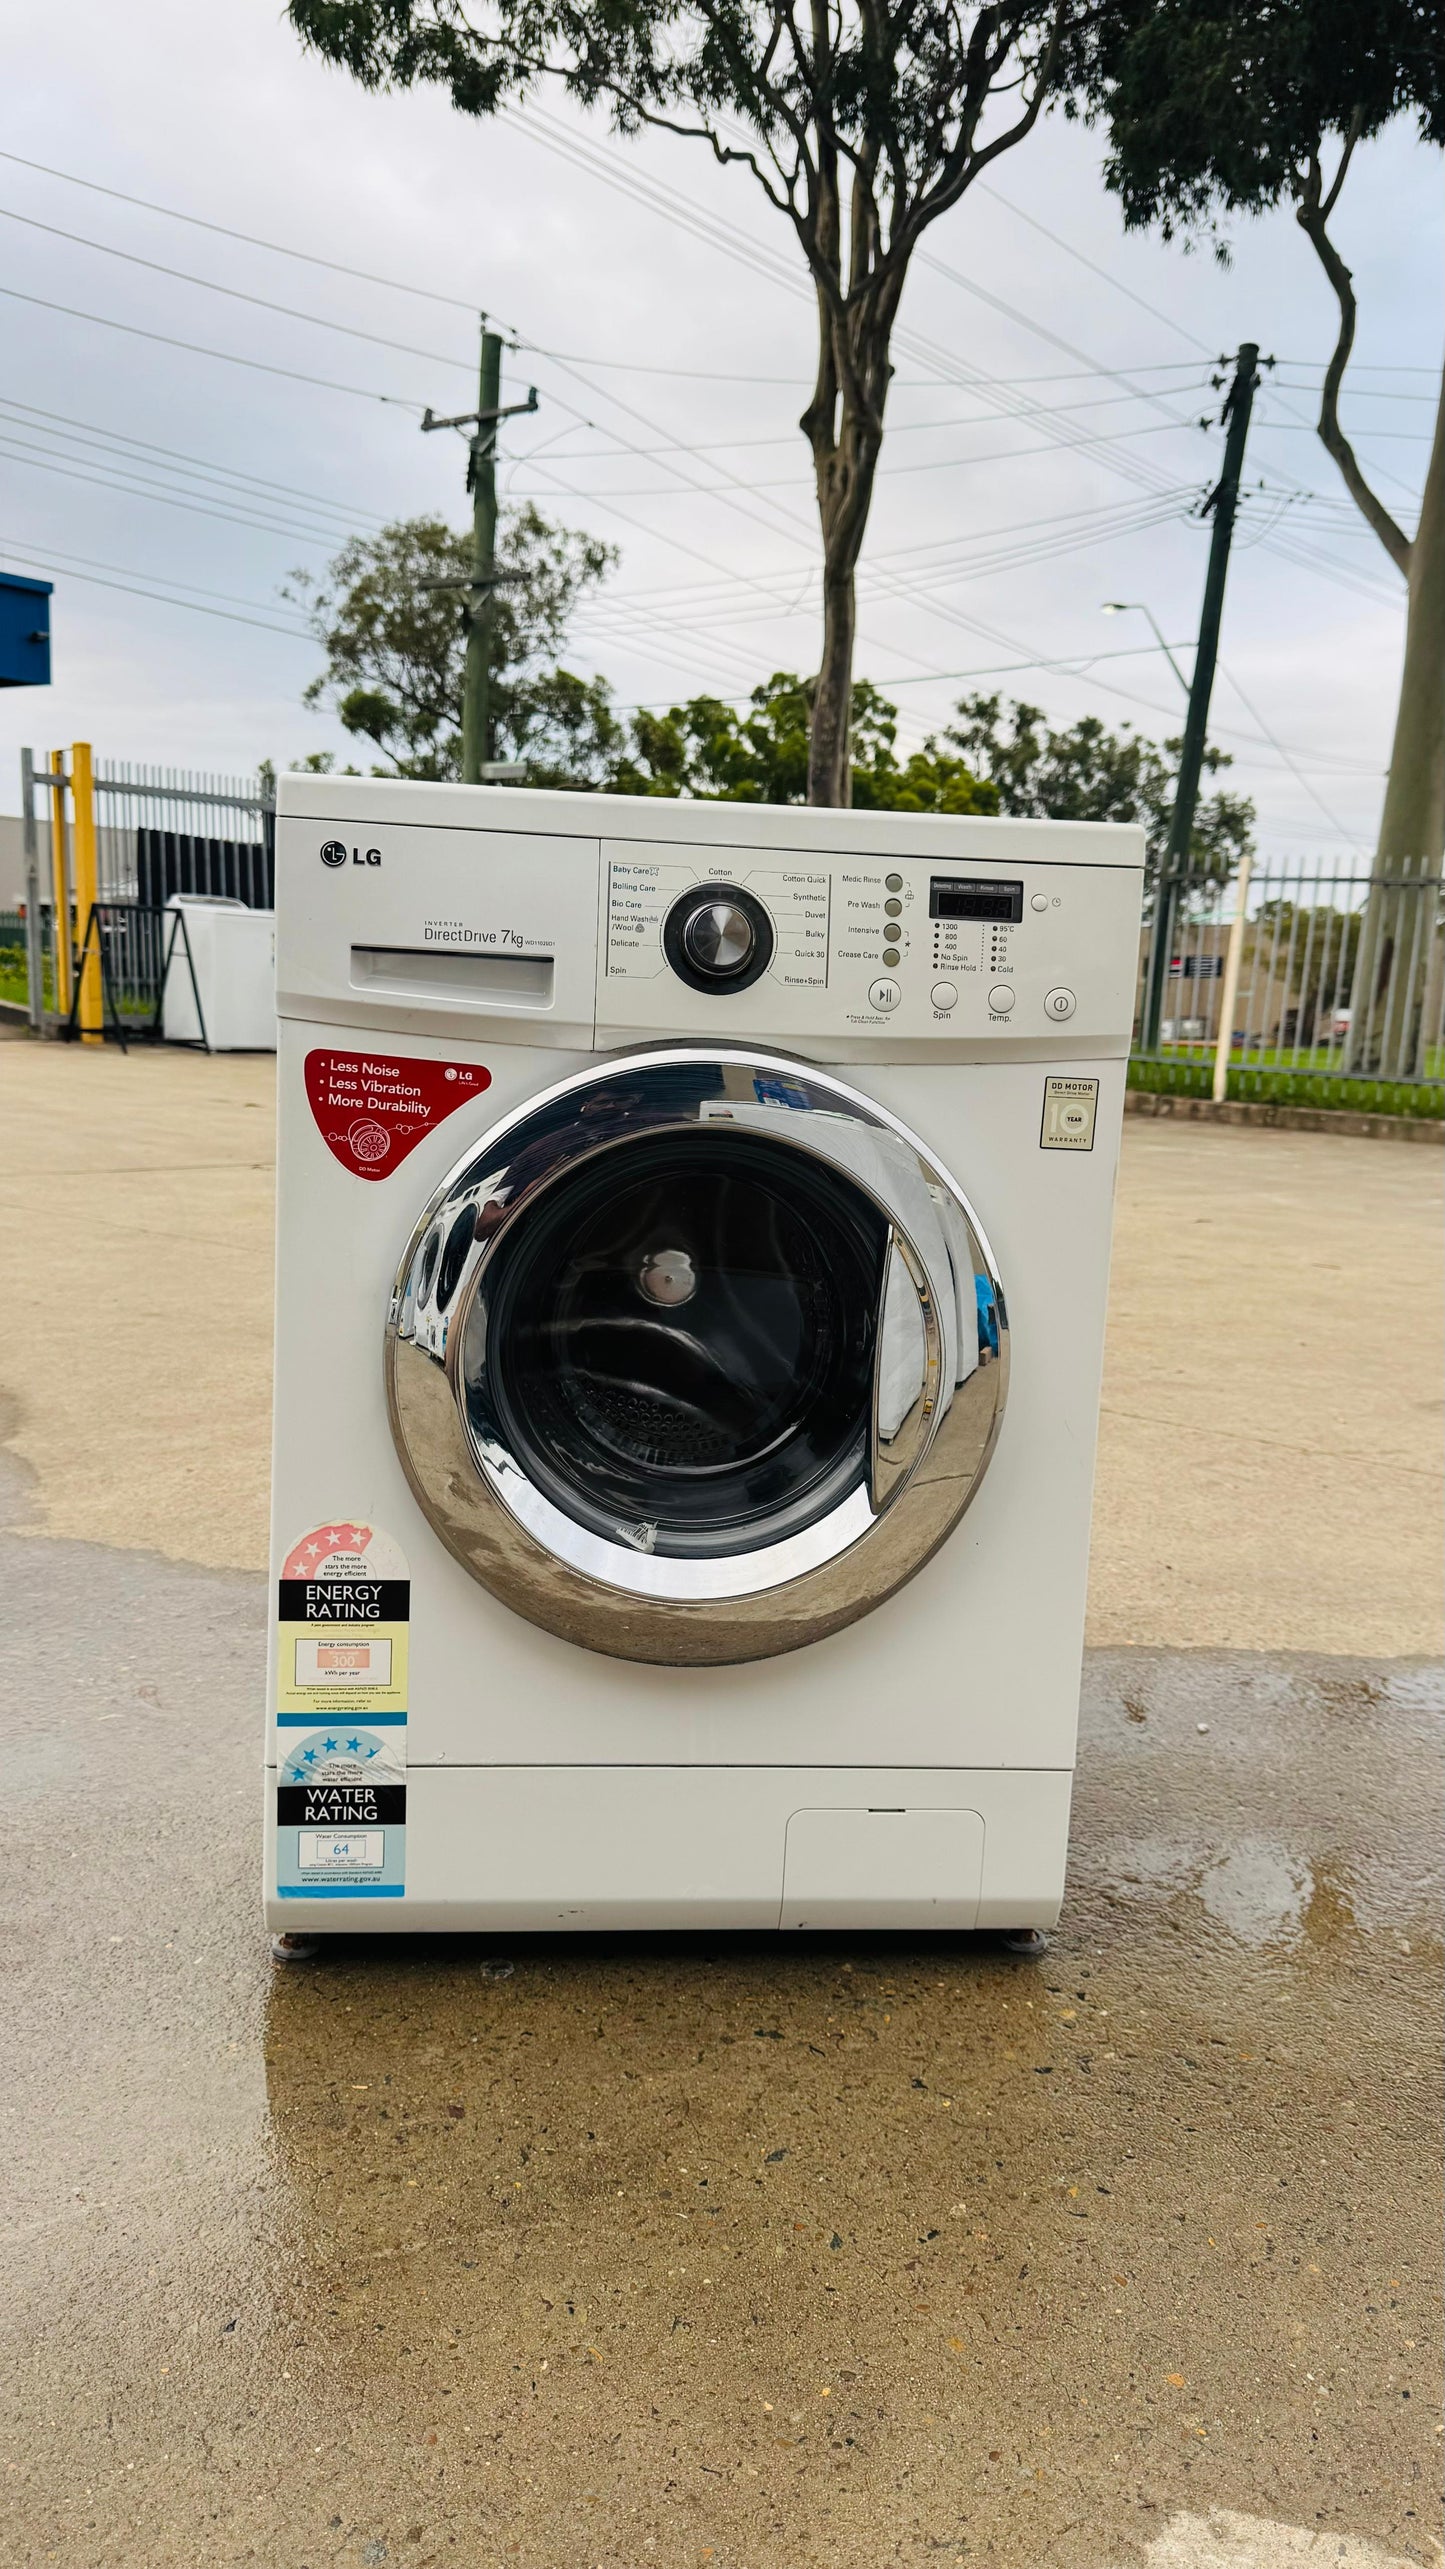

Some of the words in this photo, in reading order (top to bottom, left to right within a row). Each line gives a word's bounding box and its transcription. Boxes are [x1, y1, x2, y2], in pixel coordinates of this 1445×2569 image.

[353, 848, 381, 866] LG
[613, 865, 631, 874] Baby
[709, 868, 732, 876] Cotton
[842, 875, 862, 883] Medic
[863, 876, 881, 884] Rinse
[612, 882, 637, 892] Boiling
[639, 884, 656, 892] Care
[793, 893, 826, 901] Synthetic
[625, 900, 642, 908] Care
[847, 900, 859, 908] Pre
[861, 901, 880, 909] Wash
[805, 930, 825, 939] Bulky
[848, 926, 880, 935] Intensive
[501, 929, 523, 948] 7kg
[610, 939, 639, 947] Delicate
[838, 950, 861, 958] Crease
[952, 954, 968, 962] Spin
[610, 966, 627, 974] Spin
[961, 964, 977, 972] Hold
[933, 1011, 951, 1020] Spin
[988, 1013, 1011, 1023] Temp.
[330, 1059, 358, 1073] Less
[362, 1062, 400, 1077] Noise
[459, 1071, 472, 1080] LG
[329, 1077, 357, 1090] Less
[361, 1080, 421, 1096] Vibration
[328, 1094, 363, 1108] More
[367, 1098, 431, 1117] Durability
[306, 1585, 382, 1600] ENERGY
[306, 1603, 380, 1619] RATING
[332, 1655, 355, 1667] 300
[307, 1789, 376, 1803] WATER
[305, 1806, 378, 1821] RATING
[333, 1844, 349, 1855] 64
